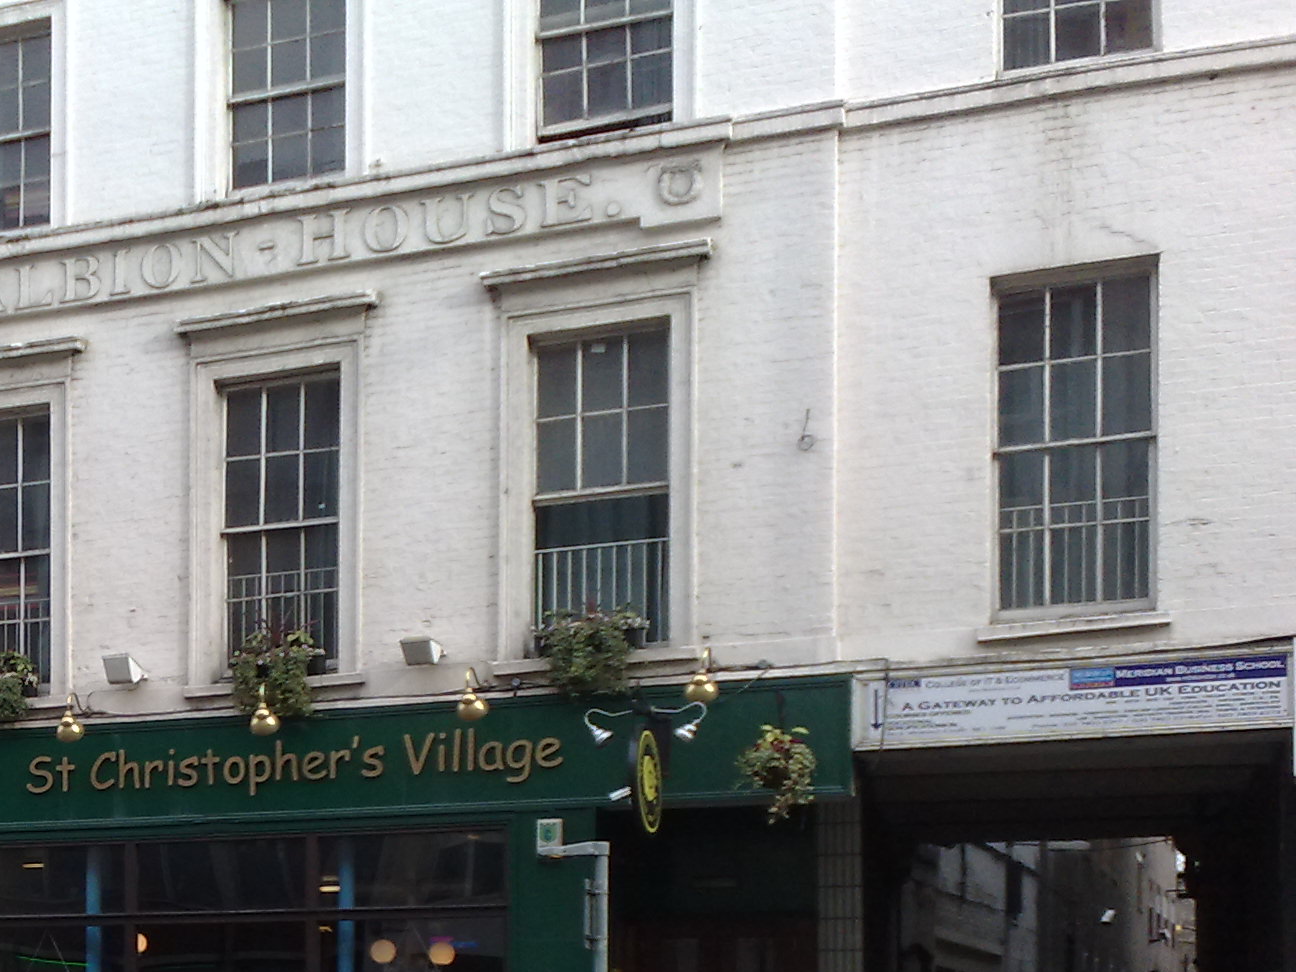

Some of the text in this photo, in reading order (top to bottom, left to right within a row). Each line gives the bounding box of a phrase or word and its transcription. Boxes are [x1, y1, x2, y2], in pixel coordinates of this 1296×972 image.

[1174, 663, 1234, 675] BUSINESS
[1234, 659, 1286, 671] SCHOOL
[903, 702, 914, 711] A
[917, 698, 996, 711] GATEWAY
[1001, 696, 1023, 705] TO
[1026, 689, 1141, 704] AFFORDABLE
[1145, 686, 1172, 697] UK
[1177, 680, 1282, 695] EDUCATION
[25, 727, 564, 796] St Christopher's Village
